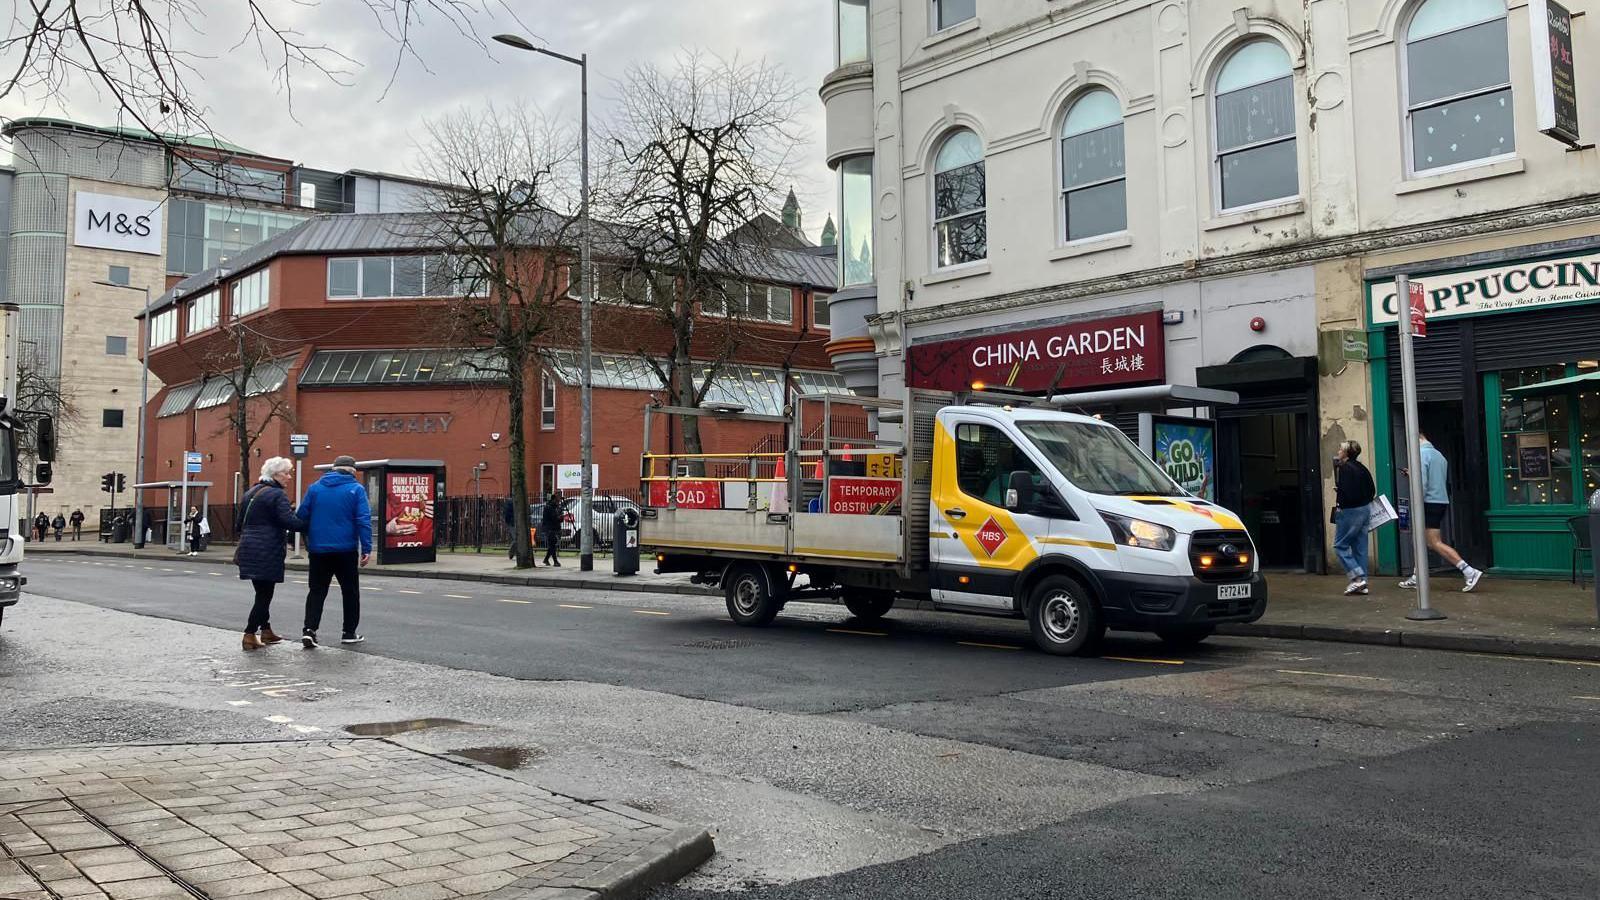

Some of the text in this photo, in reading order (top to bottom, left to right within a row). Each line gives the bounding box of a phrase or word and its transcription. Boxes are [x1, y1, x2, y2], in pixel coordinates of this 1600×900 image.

[88, 209, 151, 236] M&S
[1382, 262, 1600, 315] CPPUCCIN
[1548, 294, 1572, 302] Home
[972, 325, 1145, 367] CHINA GARDEN
[358, 415, 453, 434] LIBRARY
[1170, 440, 1194, 463] GO
[1166, 458, 1204, 482] WILD!
[392, 476, 429, 485] MINI FILLET
[840, 485, 896, 496] TEMPORARY
[834, 501, 887, 512] OBSTRU
[982, 531, 1001, 541] HBS
